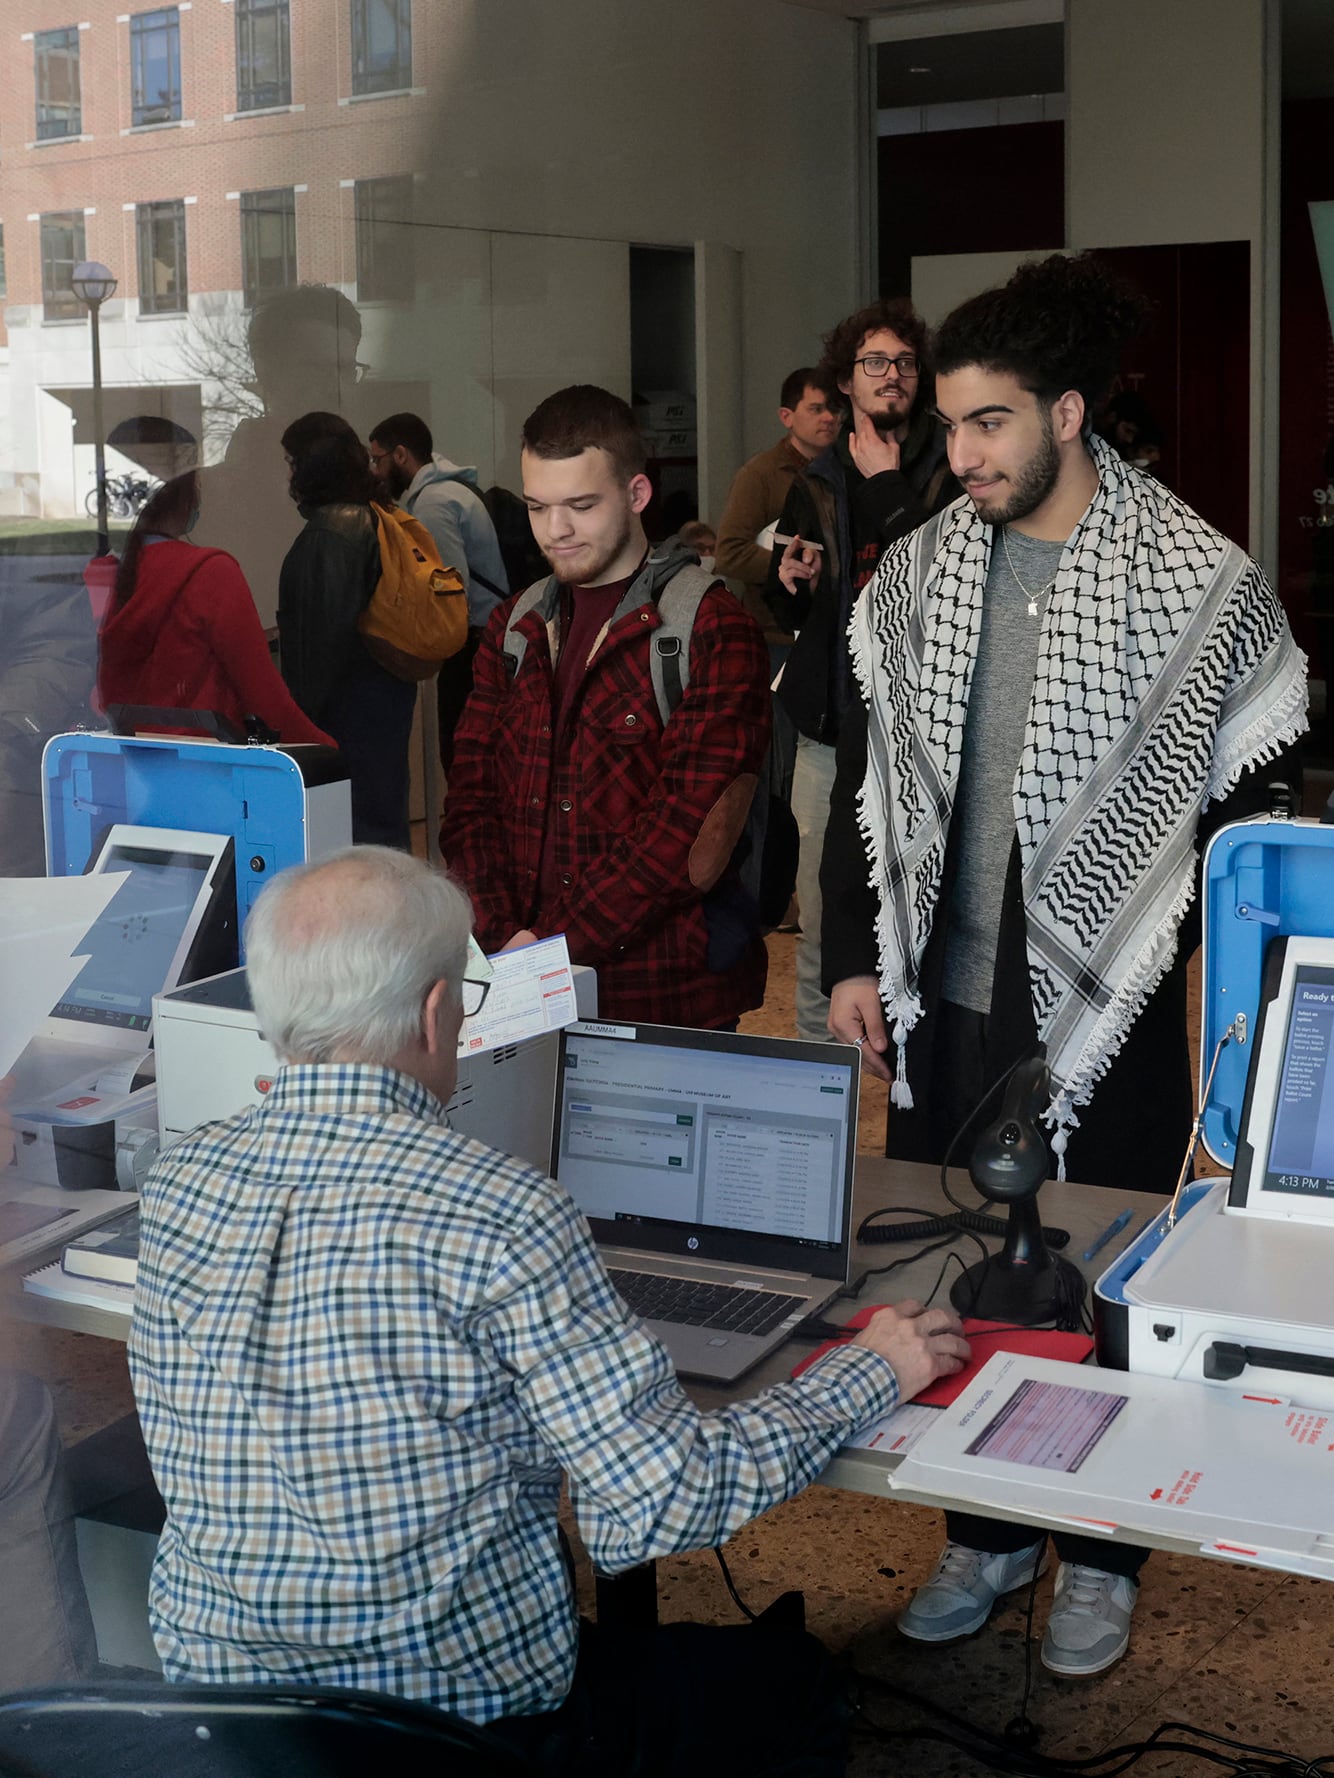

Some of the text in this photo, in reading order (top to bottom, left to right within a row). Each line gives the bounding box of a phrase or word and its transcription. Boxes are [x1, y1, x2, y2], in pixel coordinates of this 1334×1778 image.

[1303, 992, 1328, 1003] Ready
[1279, 1175, 1319, 1189] 4:13 PM
